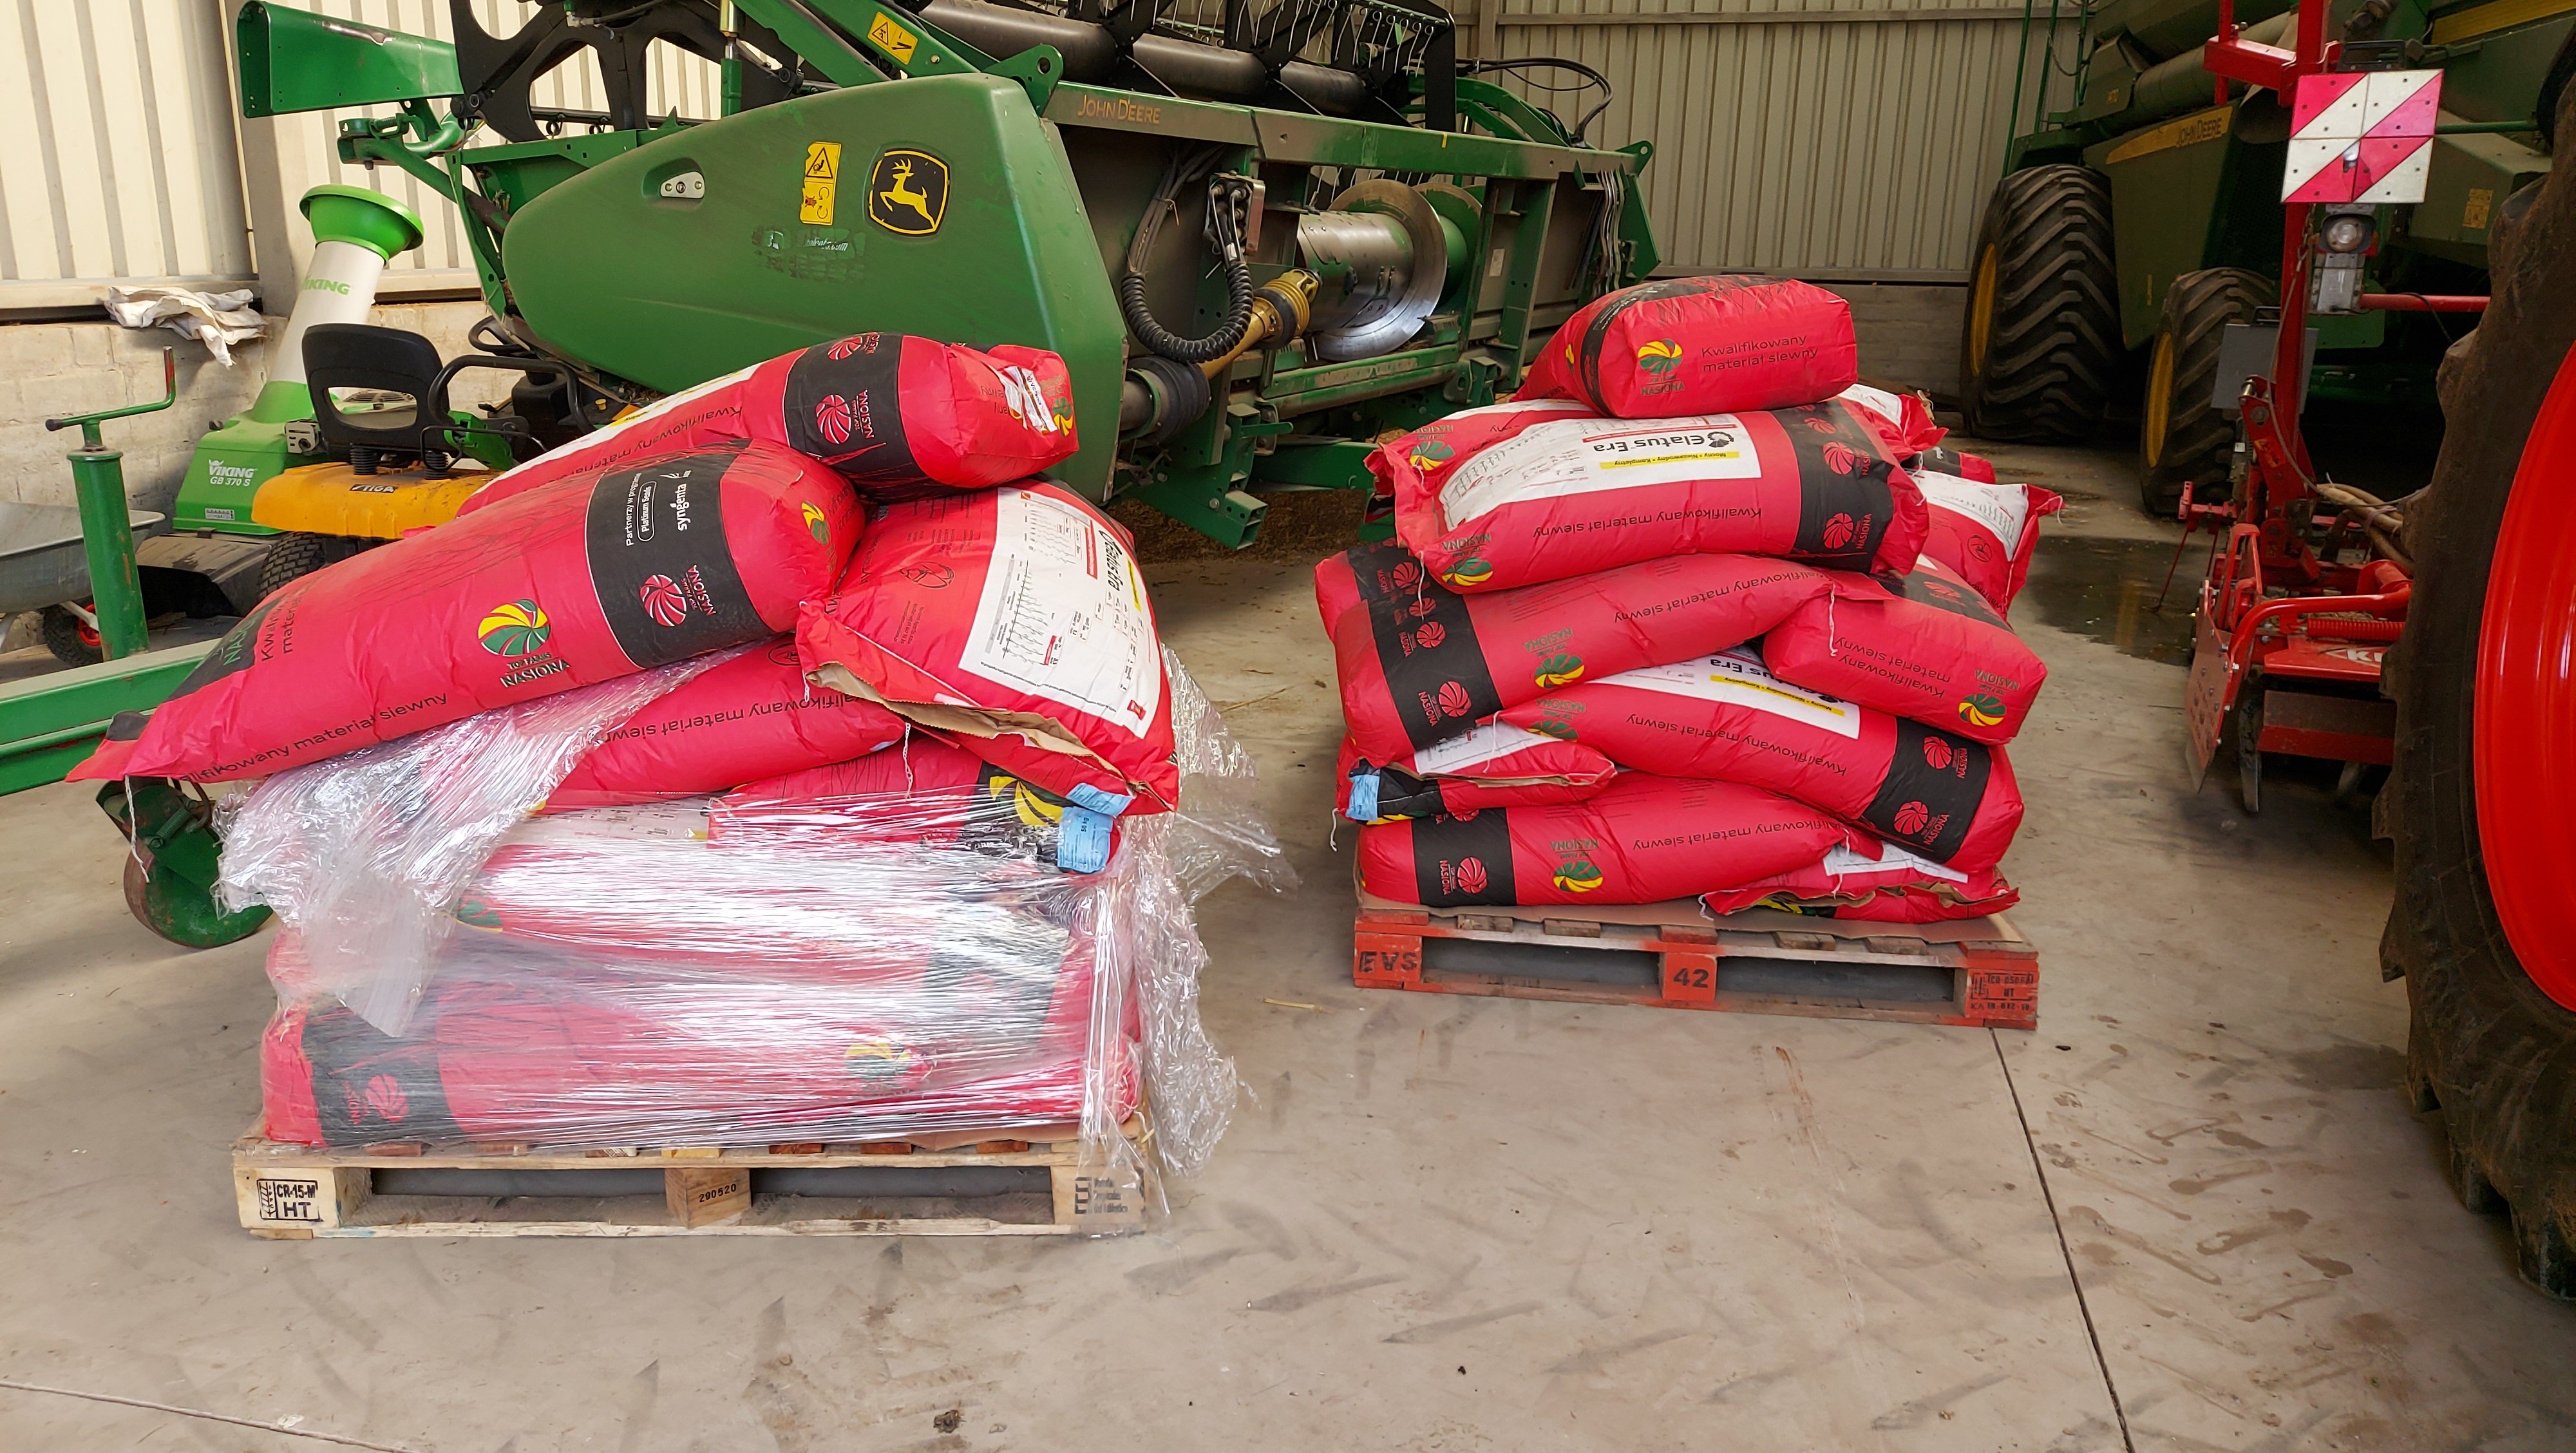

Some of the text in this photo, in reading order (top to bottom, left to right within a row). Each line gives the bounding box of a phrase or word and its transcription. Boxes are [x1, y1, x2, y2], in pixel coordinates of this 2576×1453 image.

[1077, 94, 1161, 124] JOHN DEERE
[2175, 117, 2222, 147] JOHN DEERE
[302, 279, 351, 296] IKING
[1701, 335, 1807, 359] Kwalifikowany
[1703, 348, 1819, 373] materiał siewny
[1640, 381, 1686, 395] NASIONA
[858, 388, 875, 439] NASIONA
[634, 406, 744, 448] Kwalifikowany
[1593, 435, 1705, 453] Elatus Era
[1614, 457, 1652, 466] Kompletny
[1657, 453, 1698, 462] Niezawodny
[209, 465, 256, 479] VIKING
[210, 476, 251, 487] GB 370 S
[353, 484, 397, 493] STIGA
[627, 497, 634, 505] w
[674, 482, 691, 531] syngenta
[625, 504, 634, 547] Partnerzy
[641, 502, 650, 533] Platinum
[1532, 508, 1762, 538] Kwalifikowany materiał siewny
[1443, 531, 1492, 551] NASIONA
[1855, 513, 1873, 549] NASIONA
[681, 577, 694, 598] FARMS
[687, 564, 717, 617] NASIONA
[1666, 585, 1730, 613] materiał
[1613, 604, 1664, 623] siewny
[1524, 627, 1573, 651] NASIONA
[506, 652, 552, 670] TOP FARMS
[1709, 658, 1743, 674] Era
[1834, 636, 1951, 683] materiał siewny
[499, 659, 571, 688] NASIONA
[1838, 654, 1946, 699] Kwalifikowany
[1974, 669, 2020, 690] NASIONA
[1418, 690, 1439, 727] NASIONA
[1535, 698, 1586, 714] NASIONA
[292, 714, 377, 750] materiał
[379, 692, 448, 721] siewny
[661, 708, 745, 734] materiał
[1625, 713, 1848, 777] Kwalifikowany materiał siewny
[1956, 748, 1968, 779] NASIONA
[1081, 817, 1090, 833] 50 kg
[1687, 826, 1752, 846] materiał
[1923, 813, 1950, 846] NASIONA
[1549, 837, 1600, 851] NASIONA
[1633, 837, 1685, 851] siewny
[1439, 860, 1451, 895] NASIONA
[1359, 951, 1417, 973] EVS
[1673, 967, 1709, 989] 42
[276, 1183, 316, 1199] CR-15-M
[283, 1201, 311, 1219] HT
